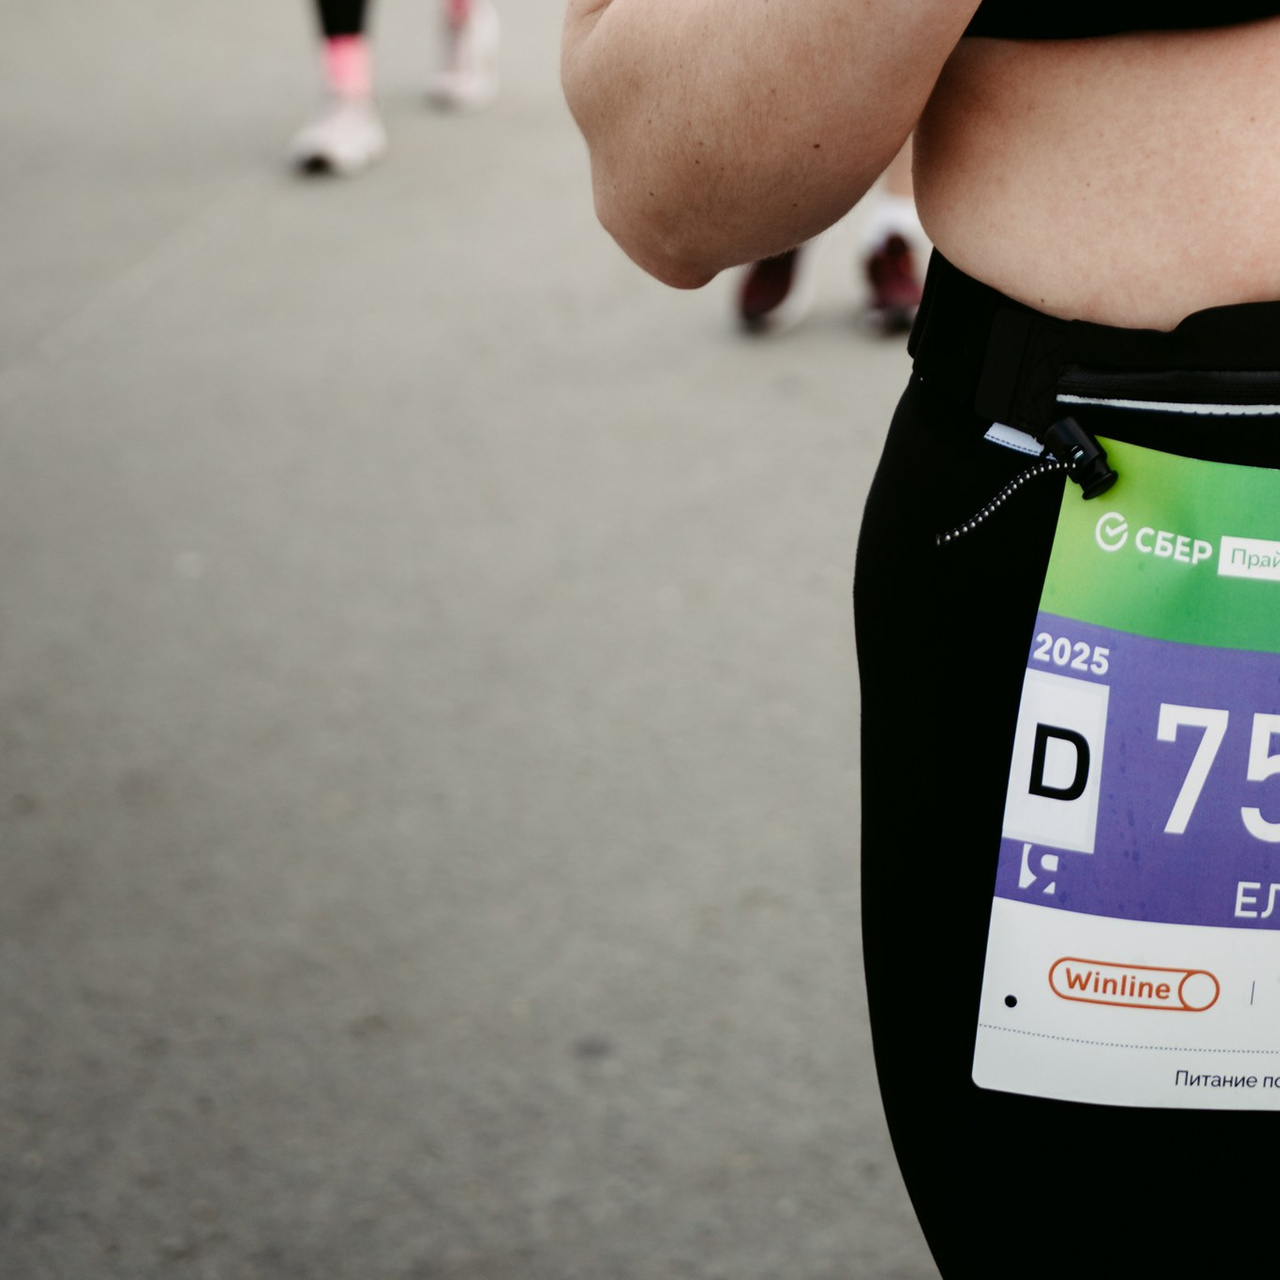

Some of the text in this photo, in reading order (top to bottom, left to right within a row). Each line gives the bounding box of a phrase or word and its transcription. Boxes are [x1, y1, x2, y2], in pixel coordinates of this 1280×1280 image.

[1135, 526, 1213, 565] СБЕР
[1033, 632, 1110, 675] 2025
[1028, 722, 1091, 802] D
[1065, 967, 1171, 1000] Winline
[1175, 1069, 1258, 1089] Питание
